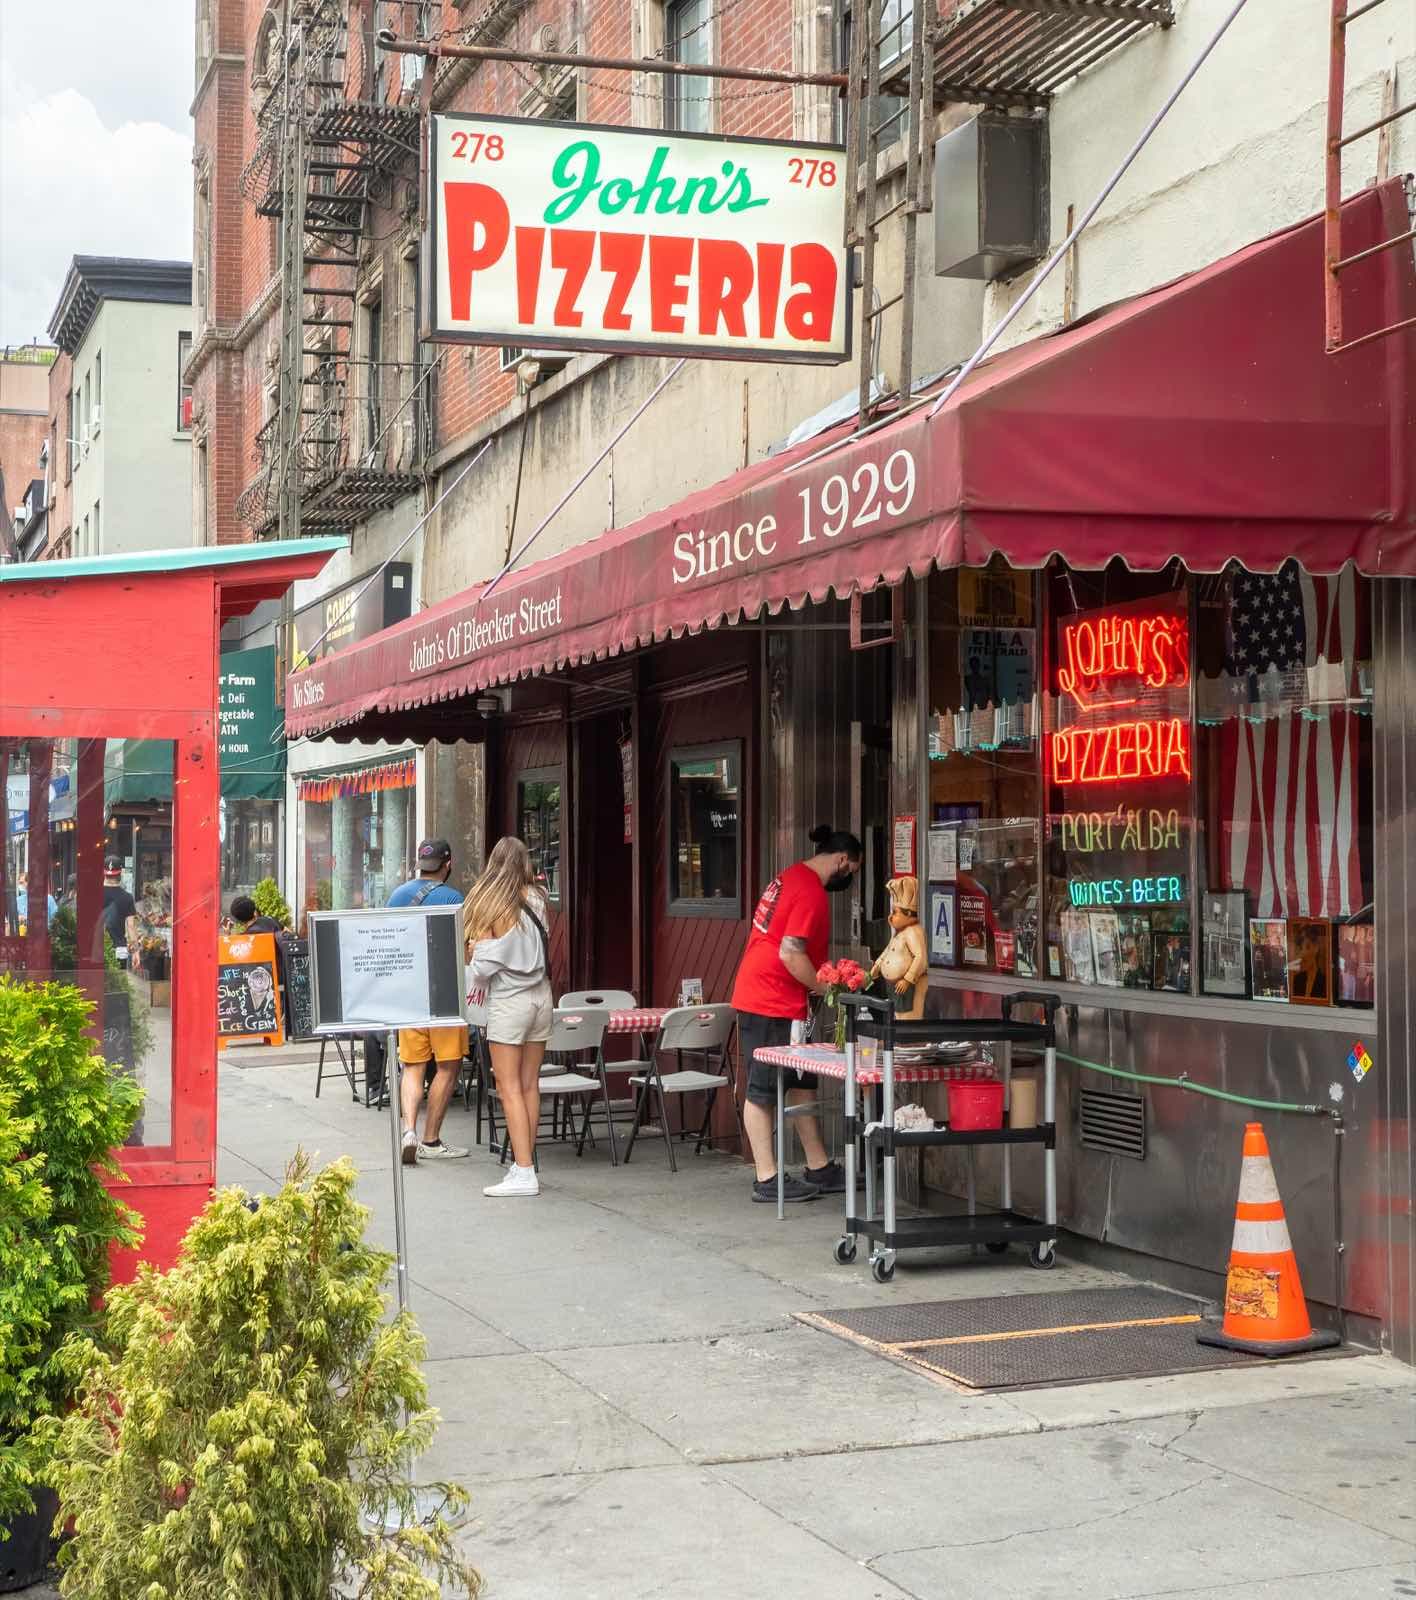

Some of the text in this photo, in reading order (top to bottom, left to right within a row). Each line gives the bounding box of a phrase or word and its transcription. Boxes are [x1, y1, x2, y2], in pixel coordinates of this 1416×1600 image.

[450, 131, 505, 163] 278
[543, 140, 771, 225] John's
[787, 157, 837, 188] 278
[672, 449, 916, 583] Since 1929
[409, 584, 563, 673] John's Of Bleecker Street
[1058, 615, 1175, 688] JOHN'S
[228, 673, 256, 686] Farm
[292, 679, 325, 709] No Slices
[228, 692, 245, 704] Deli
[220, 723, 239, 735] ATM
[228, 743, 249, 753] HOUR
[1053, 718, 1192, 784] PIZZERIA
[936, 901, 950, 938] A
